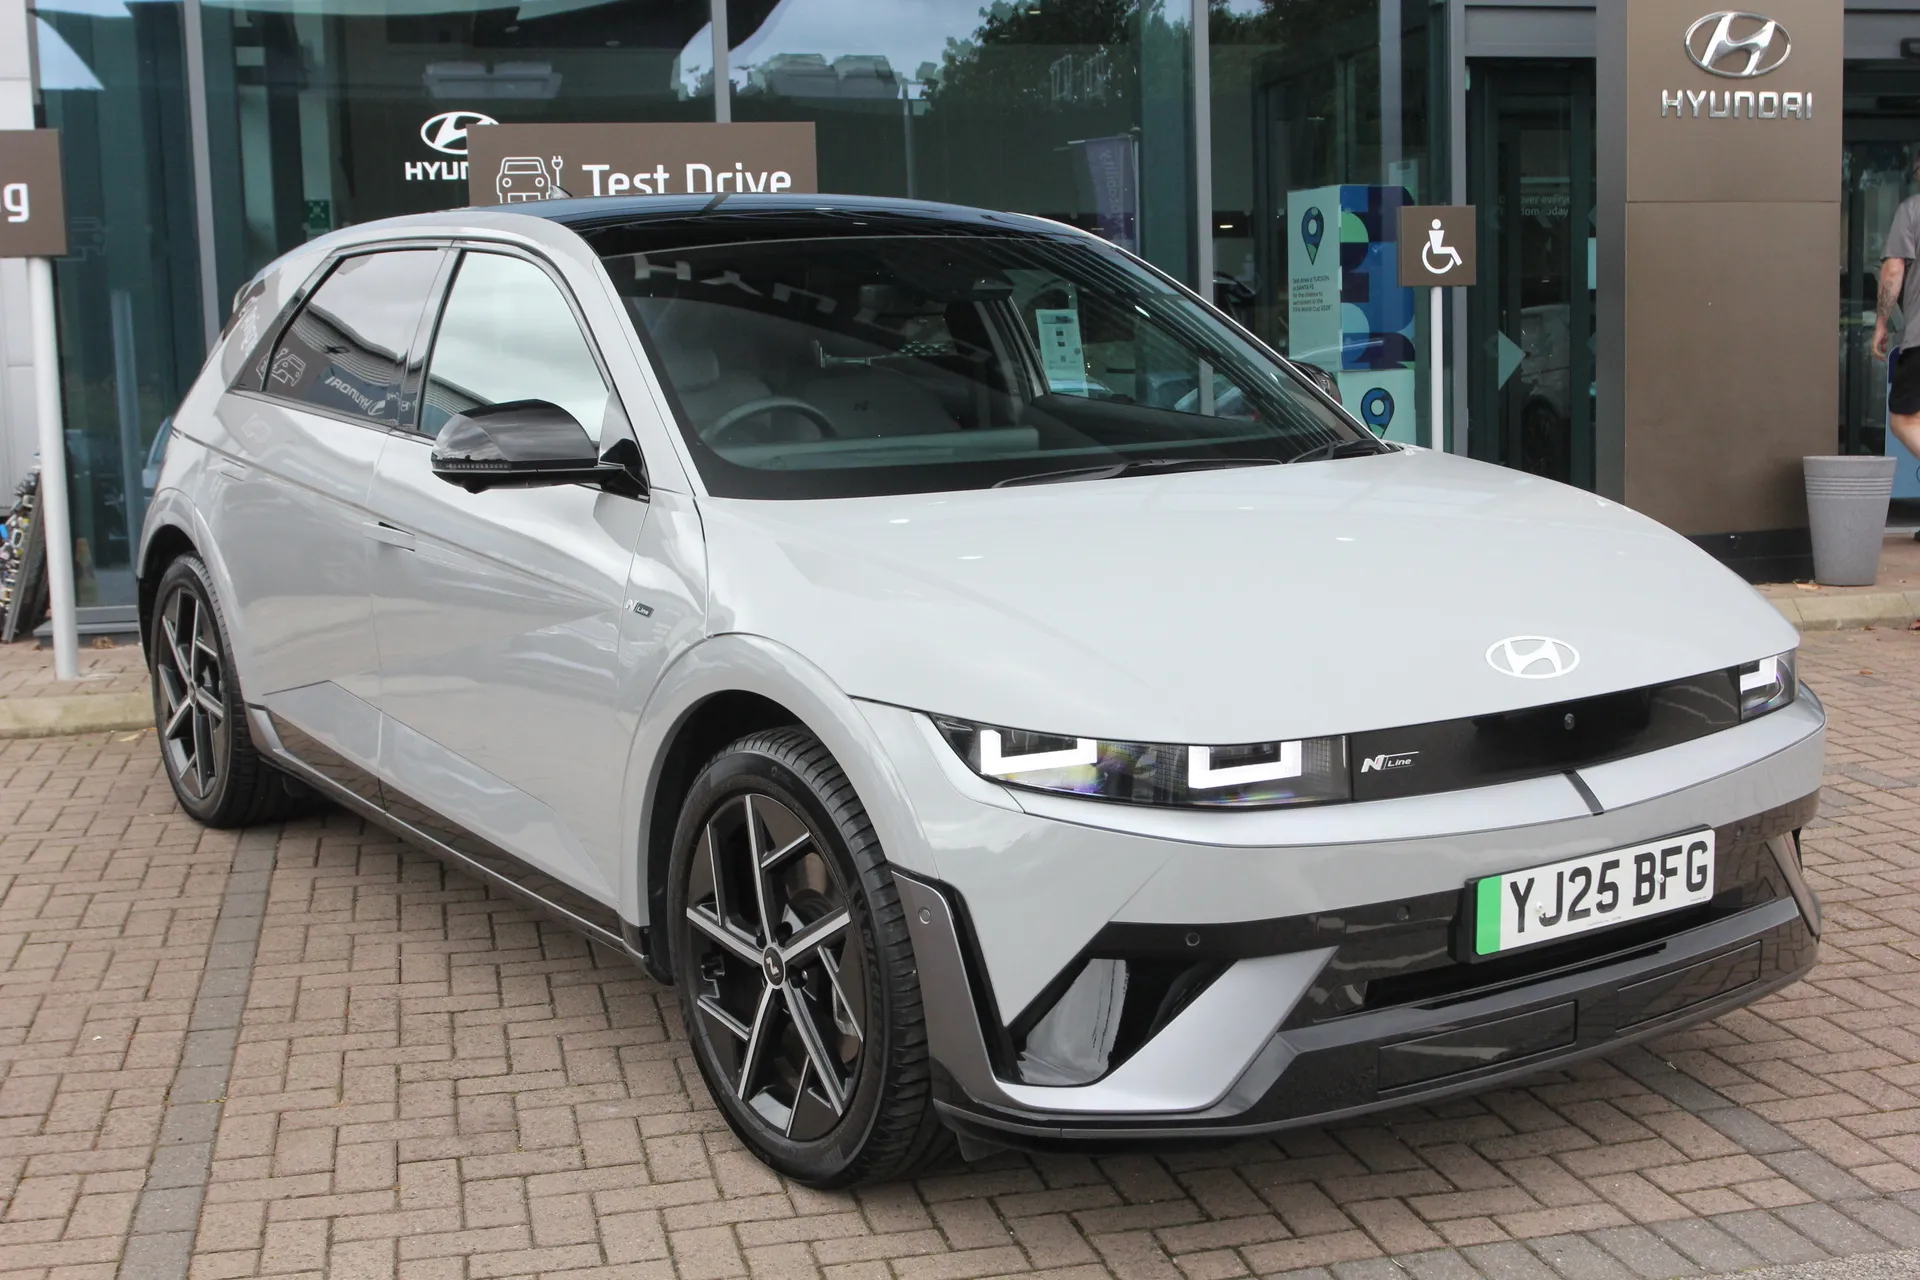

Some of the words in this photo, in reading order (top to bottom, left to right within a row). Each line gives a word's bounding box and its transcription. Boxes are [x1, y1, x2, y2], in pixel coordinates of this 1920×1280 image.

[1661, 89, 1813, 119] HYUNDAI
[581, 164, 670, 196] Test
[686, 162, 792, 193] Drive
[1387, 758, 1412, 767] Line
[1509, 858, 1620, 934] YJ25
[1632, 840, 1709, 907] BFG
